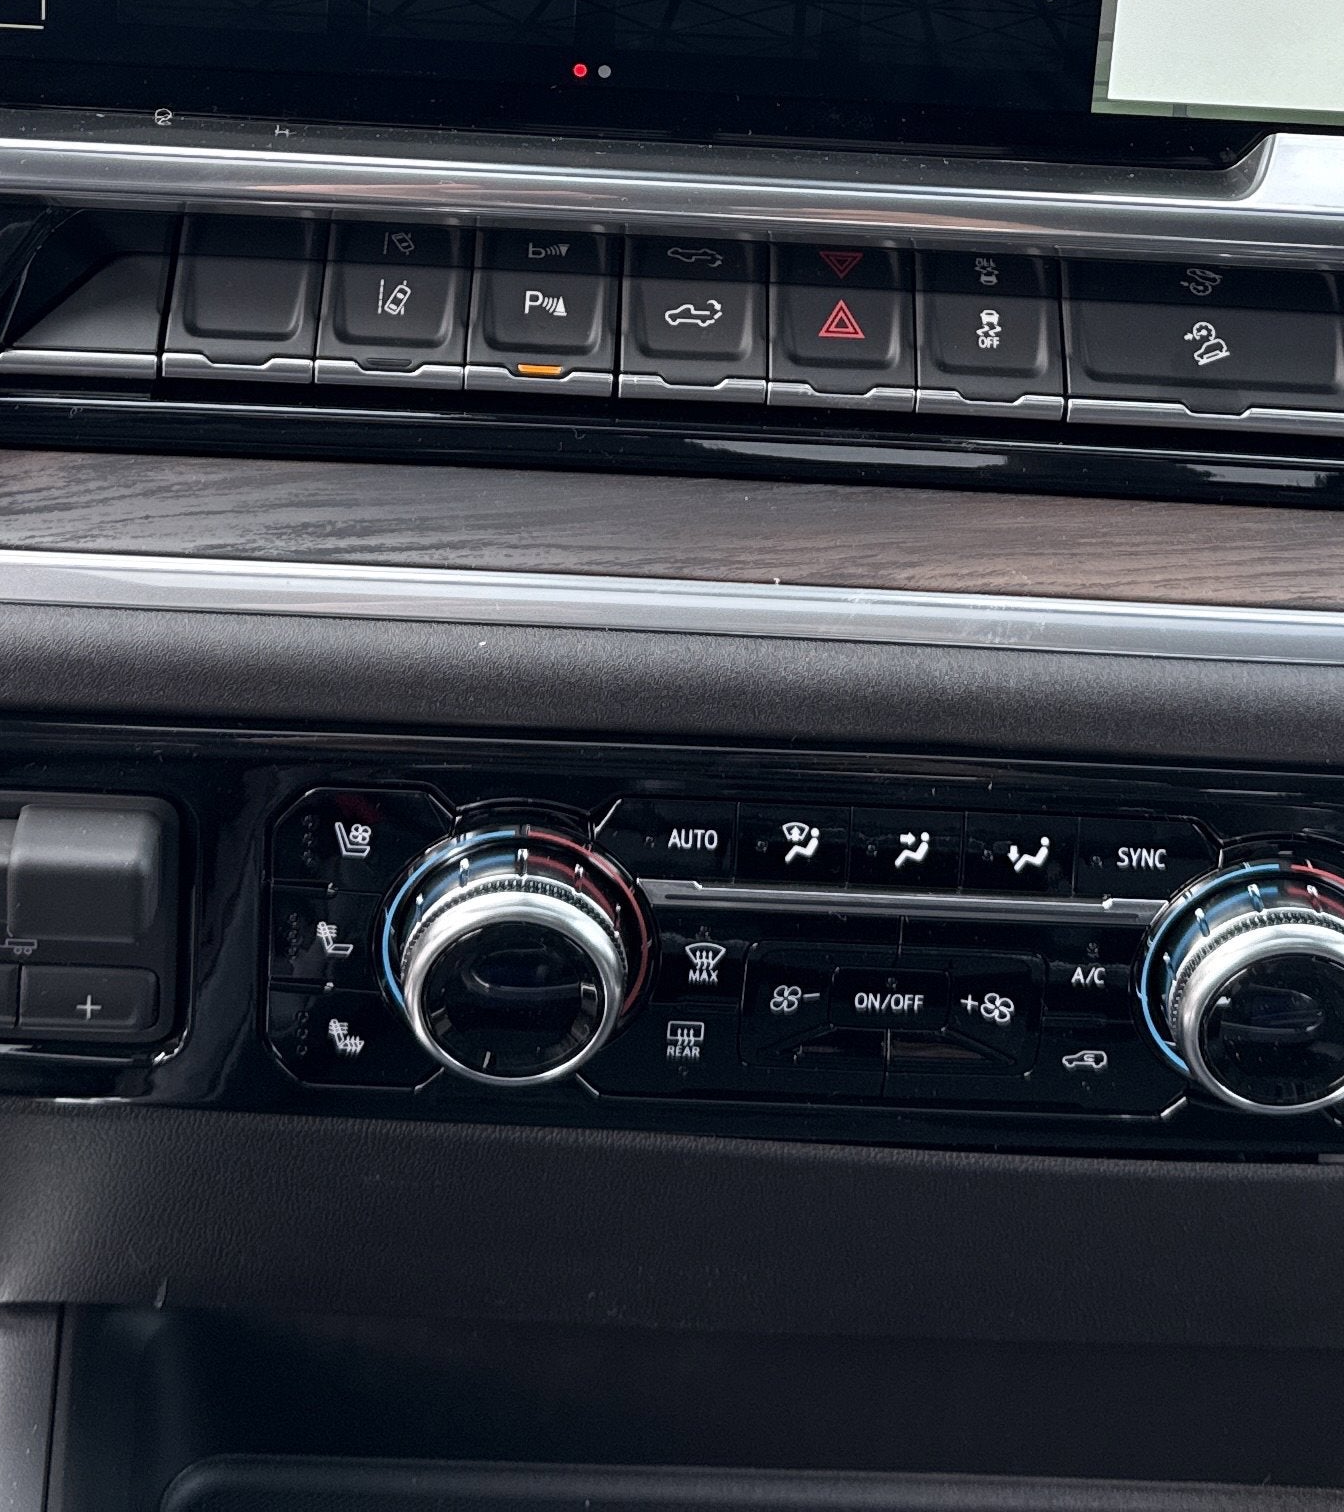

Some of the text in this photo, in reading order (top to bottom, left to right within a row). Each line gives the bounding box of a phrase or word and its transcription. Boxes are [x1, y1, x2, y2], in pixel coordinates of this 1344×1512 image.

[978, 336, 1000, 349] OFF
[667, 828, 718, 850] AUTO
[1116, 846, 1167, 870] SYNC
[688, 968, 719, 983] MAX
[1071, 966, 1106, 985] A/C
[854, 992, 924, 1012] ON/OFF
[666, 1045, 701, 1058] REAR
